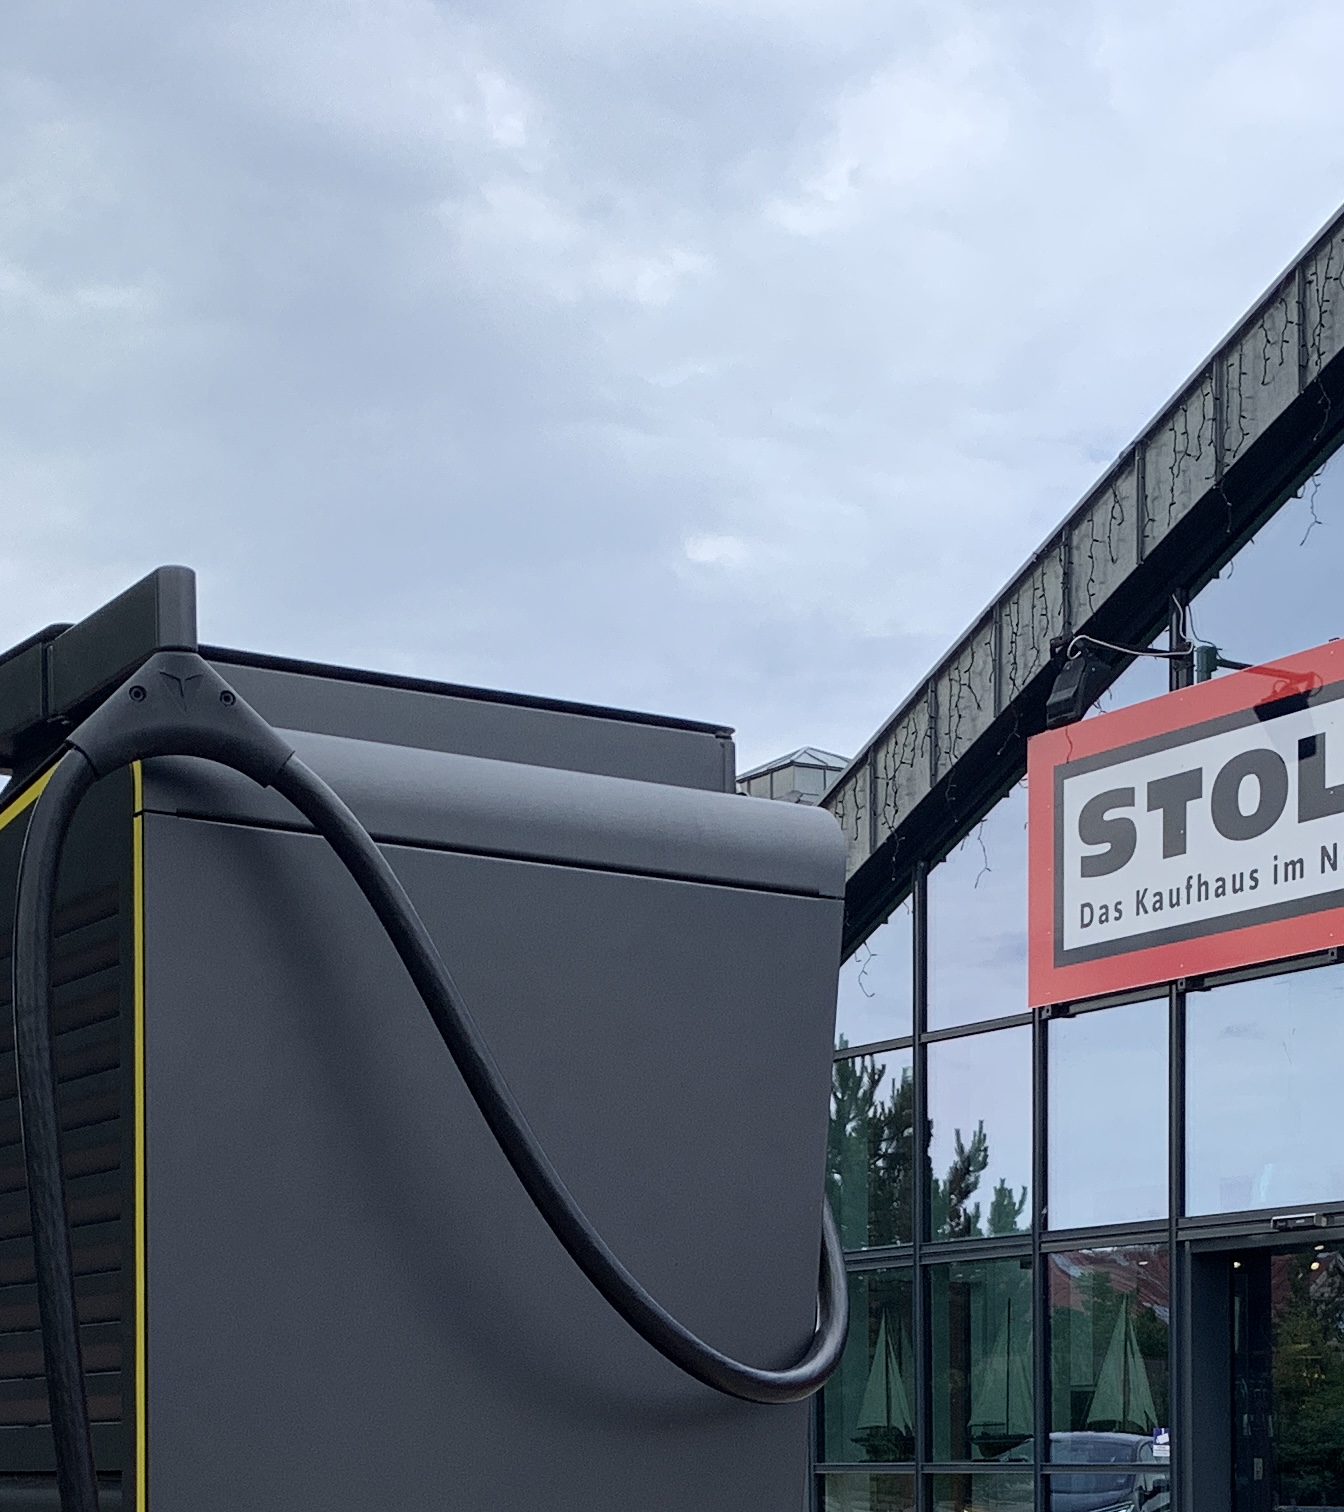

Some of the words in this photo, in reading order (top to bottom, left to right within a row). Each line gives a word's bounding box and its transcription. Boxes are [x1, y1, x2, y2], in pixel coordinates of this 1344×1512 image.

[1079, 899, 1124, 930] Das
[1135, 866, 1260, 917] Kaufhaus
[1272, 854, 1305, 885] im
